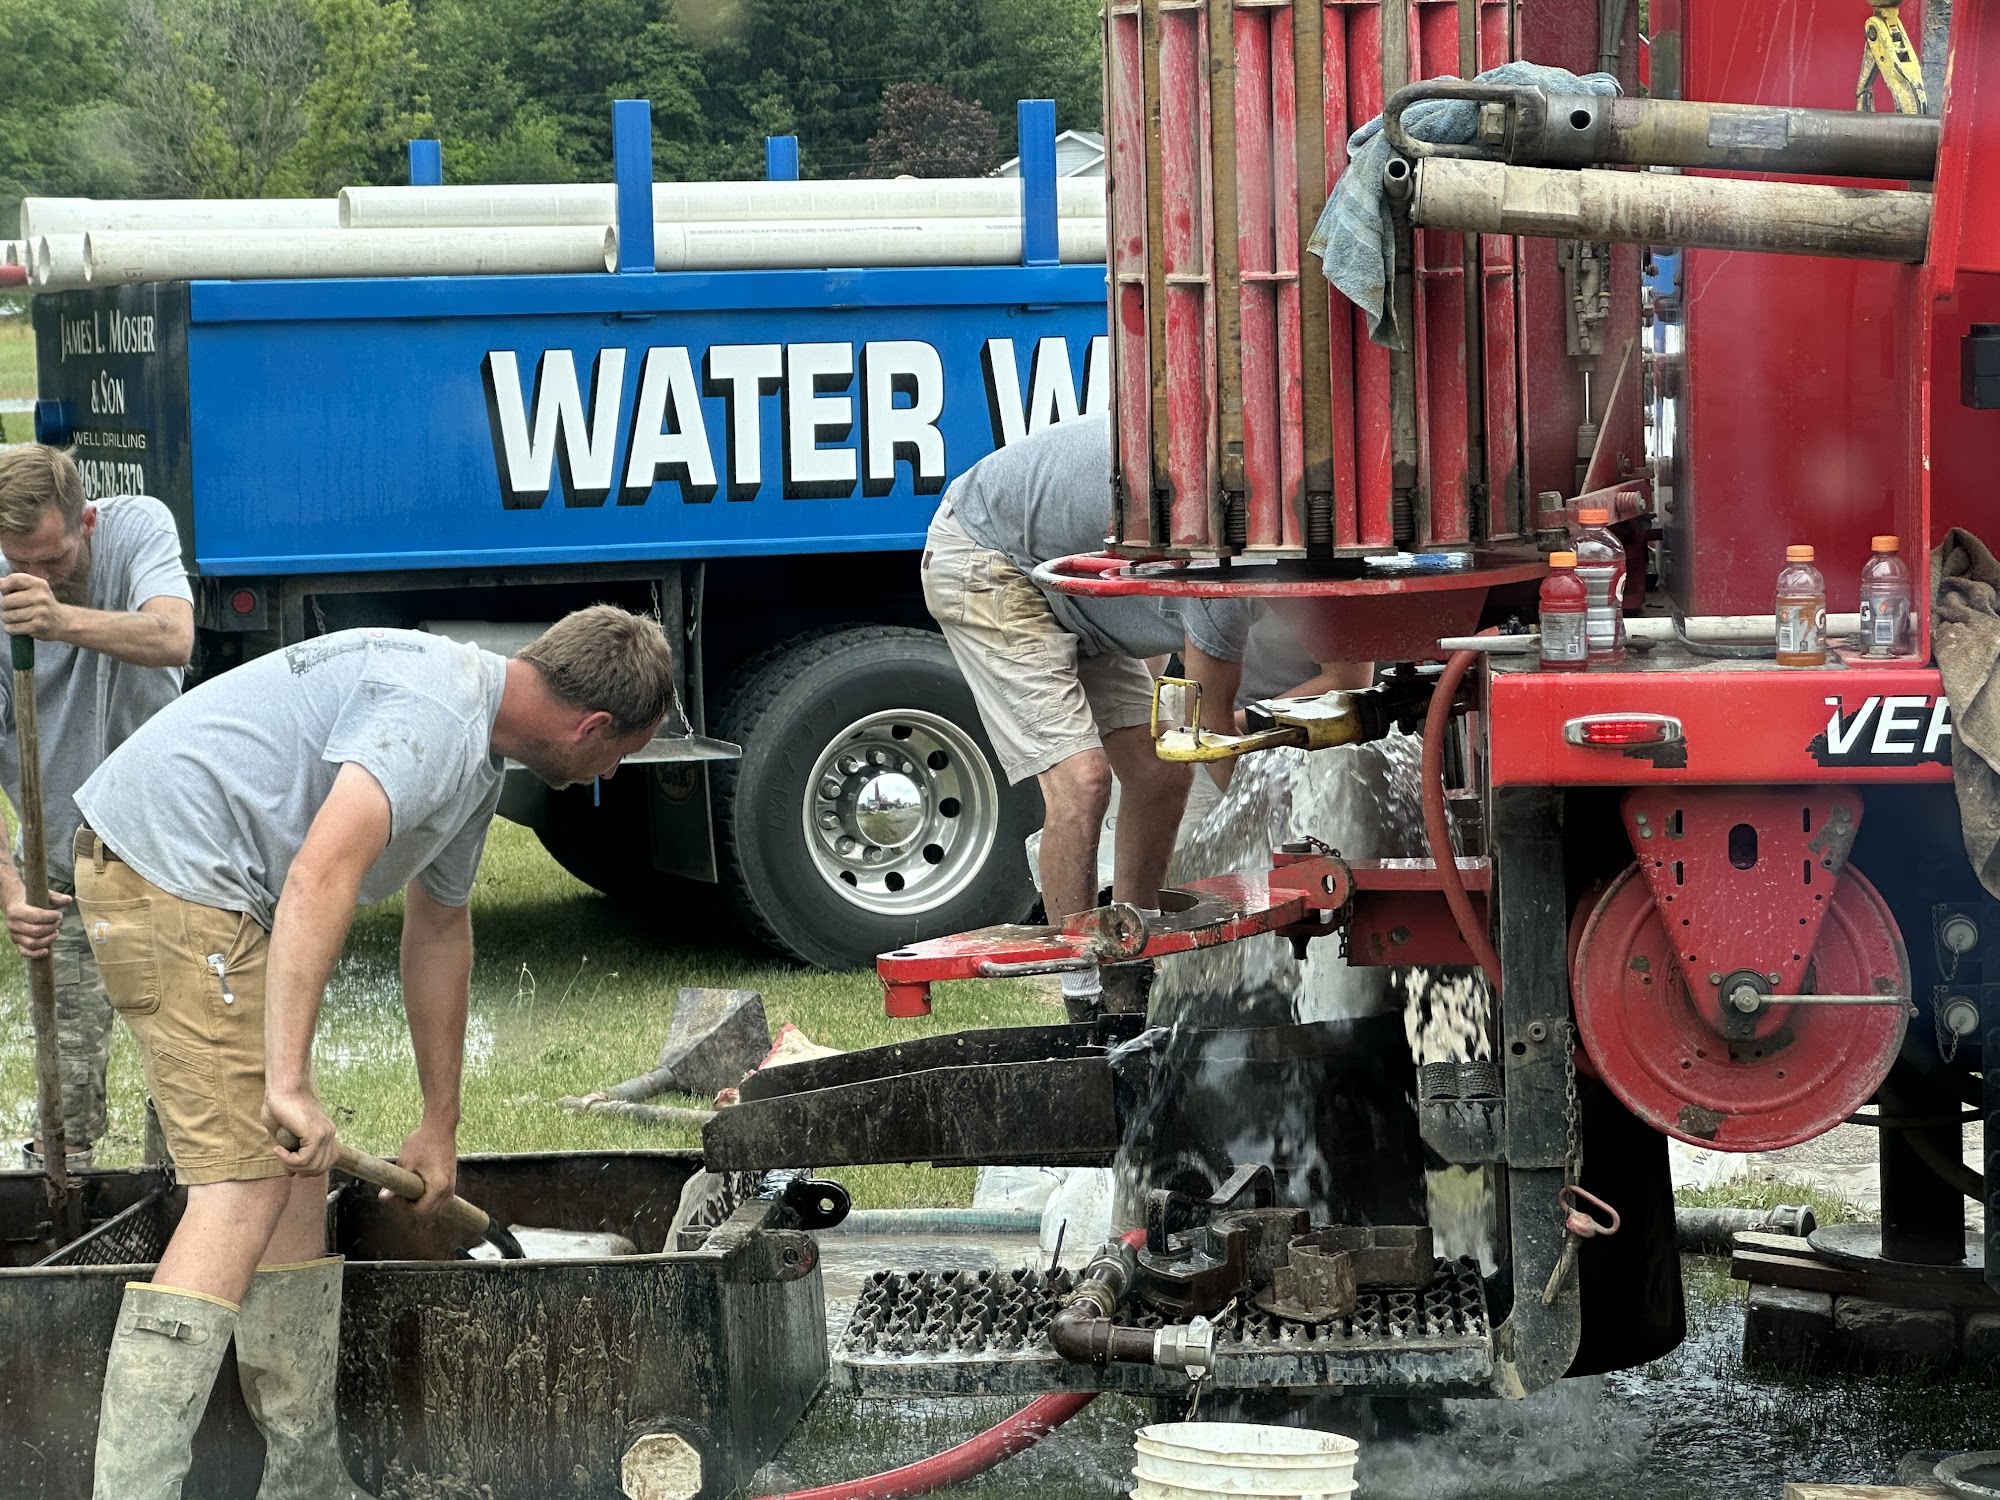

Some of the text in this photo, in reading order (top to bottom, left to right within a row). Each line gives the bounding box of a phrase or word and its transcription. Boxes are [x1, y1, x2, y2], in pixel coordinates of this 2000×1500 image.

[94, 310, 106, 354] L.
[91, 379, 99, 414] &
[72, 430, 146, 449] WELL DRILLING
[482, 340, 947, 506] WATER
